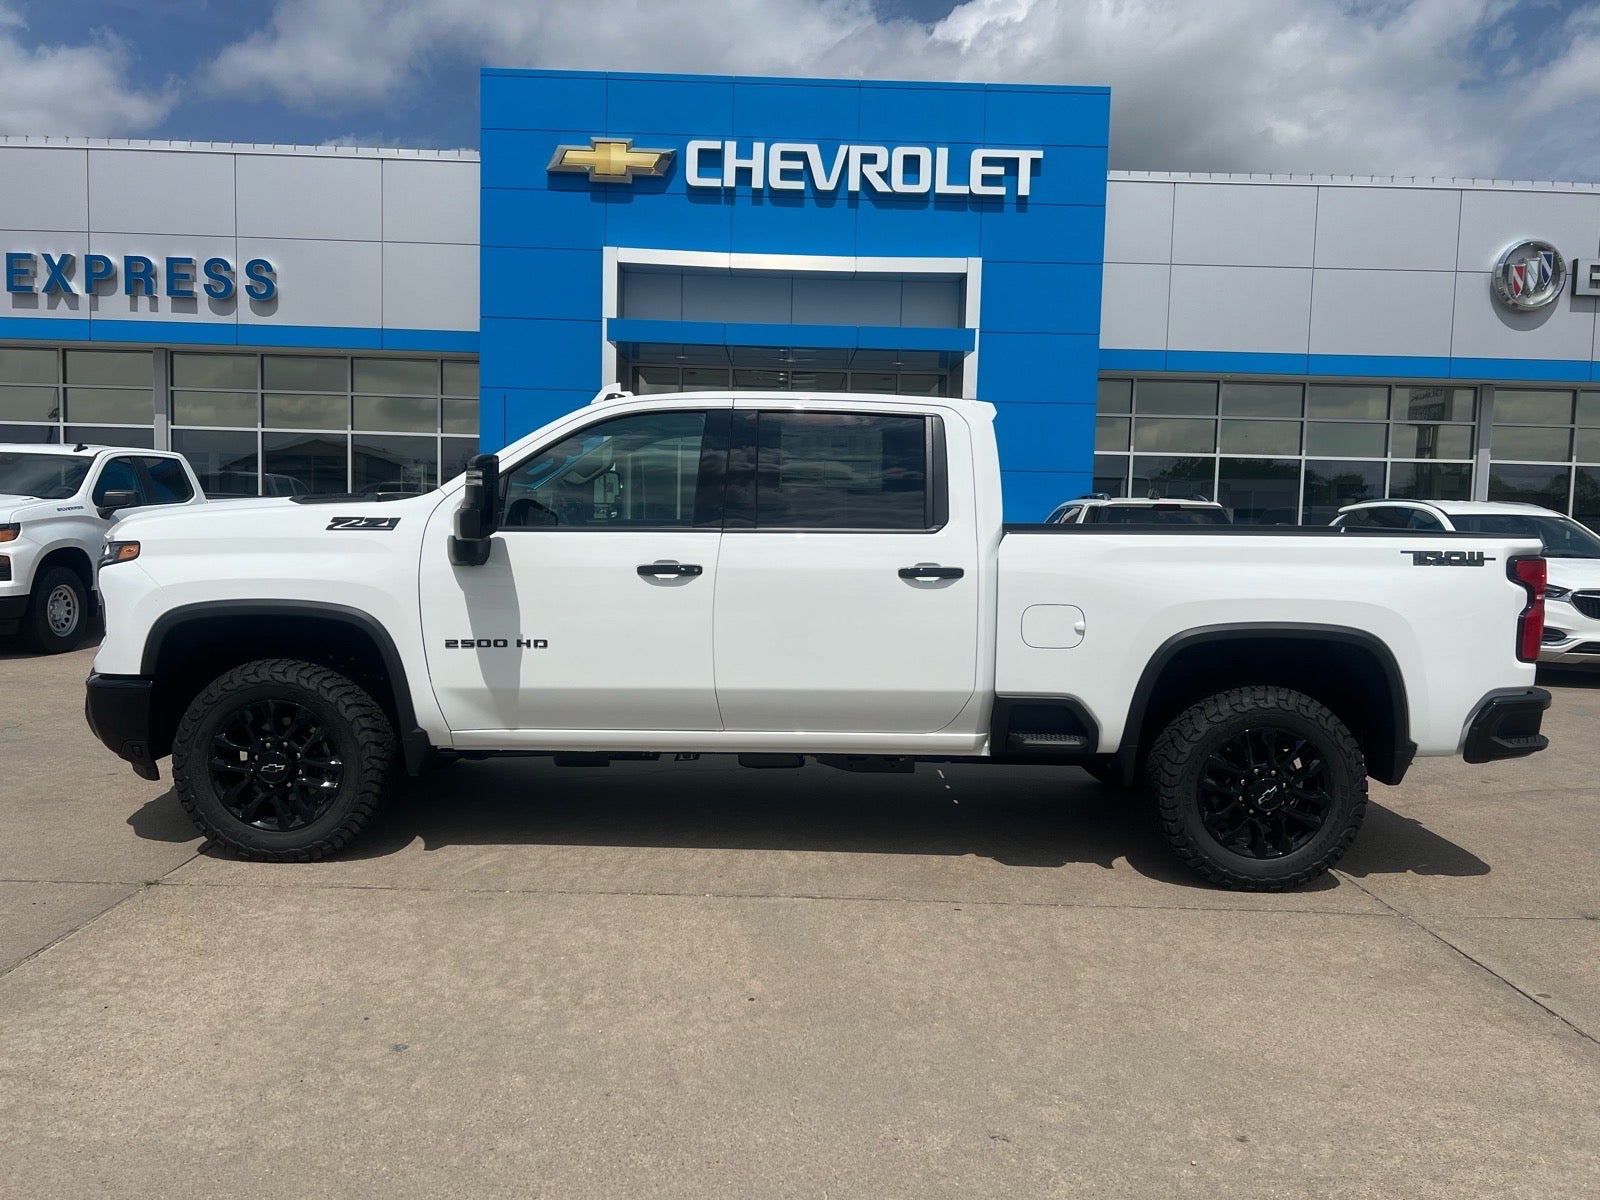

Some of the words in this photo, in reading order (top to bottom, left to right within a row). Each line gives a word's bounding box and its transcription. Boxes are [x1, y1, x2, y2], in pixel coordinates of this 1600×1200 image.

[684, 139, 1044, 197] CHEVROLET
[5, 252, 278, 301] EXPRESS
[325, 516, 402, 531] Z71
[444, 638, 508, 649] 2500
[516, 638, 548, 649] HD
